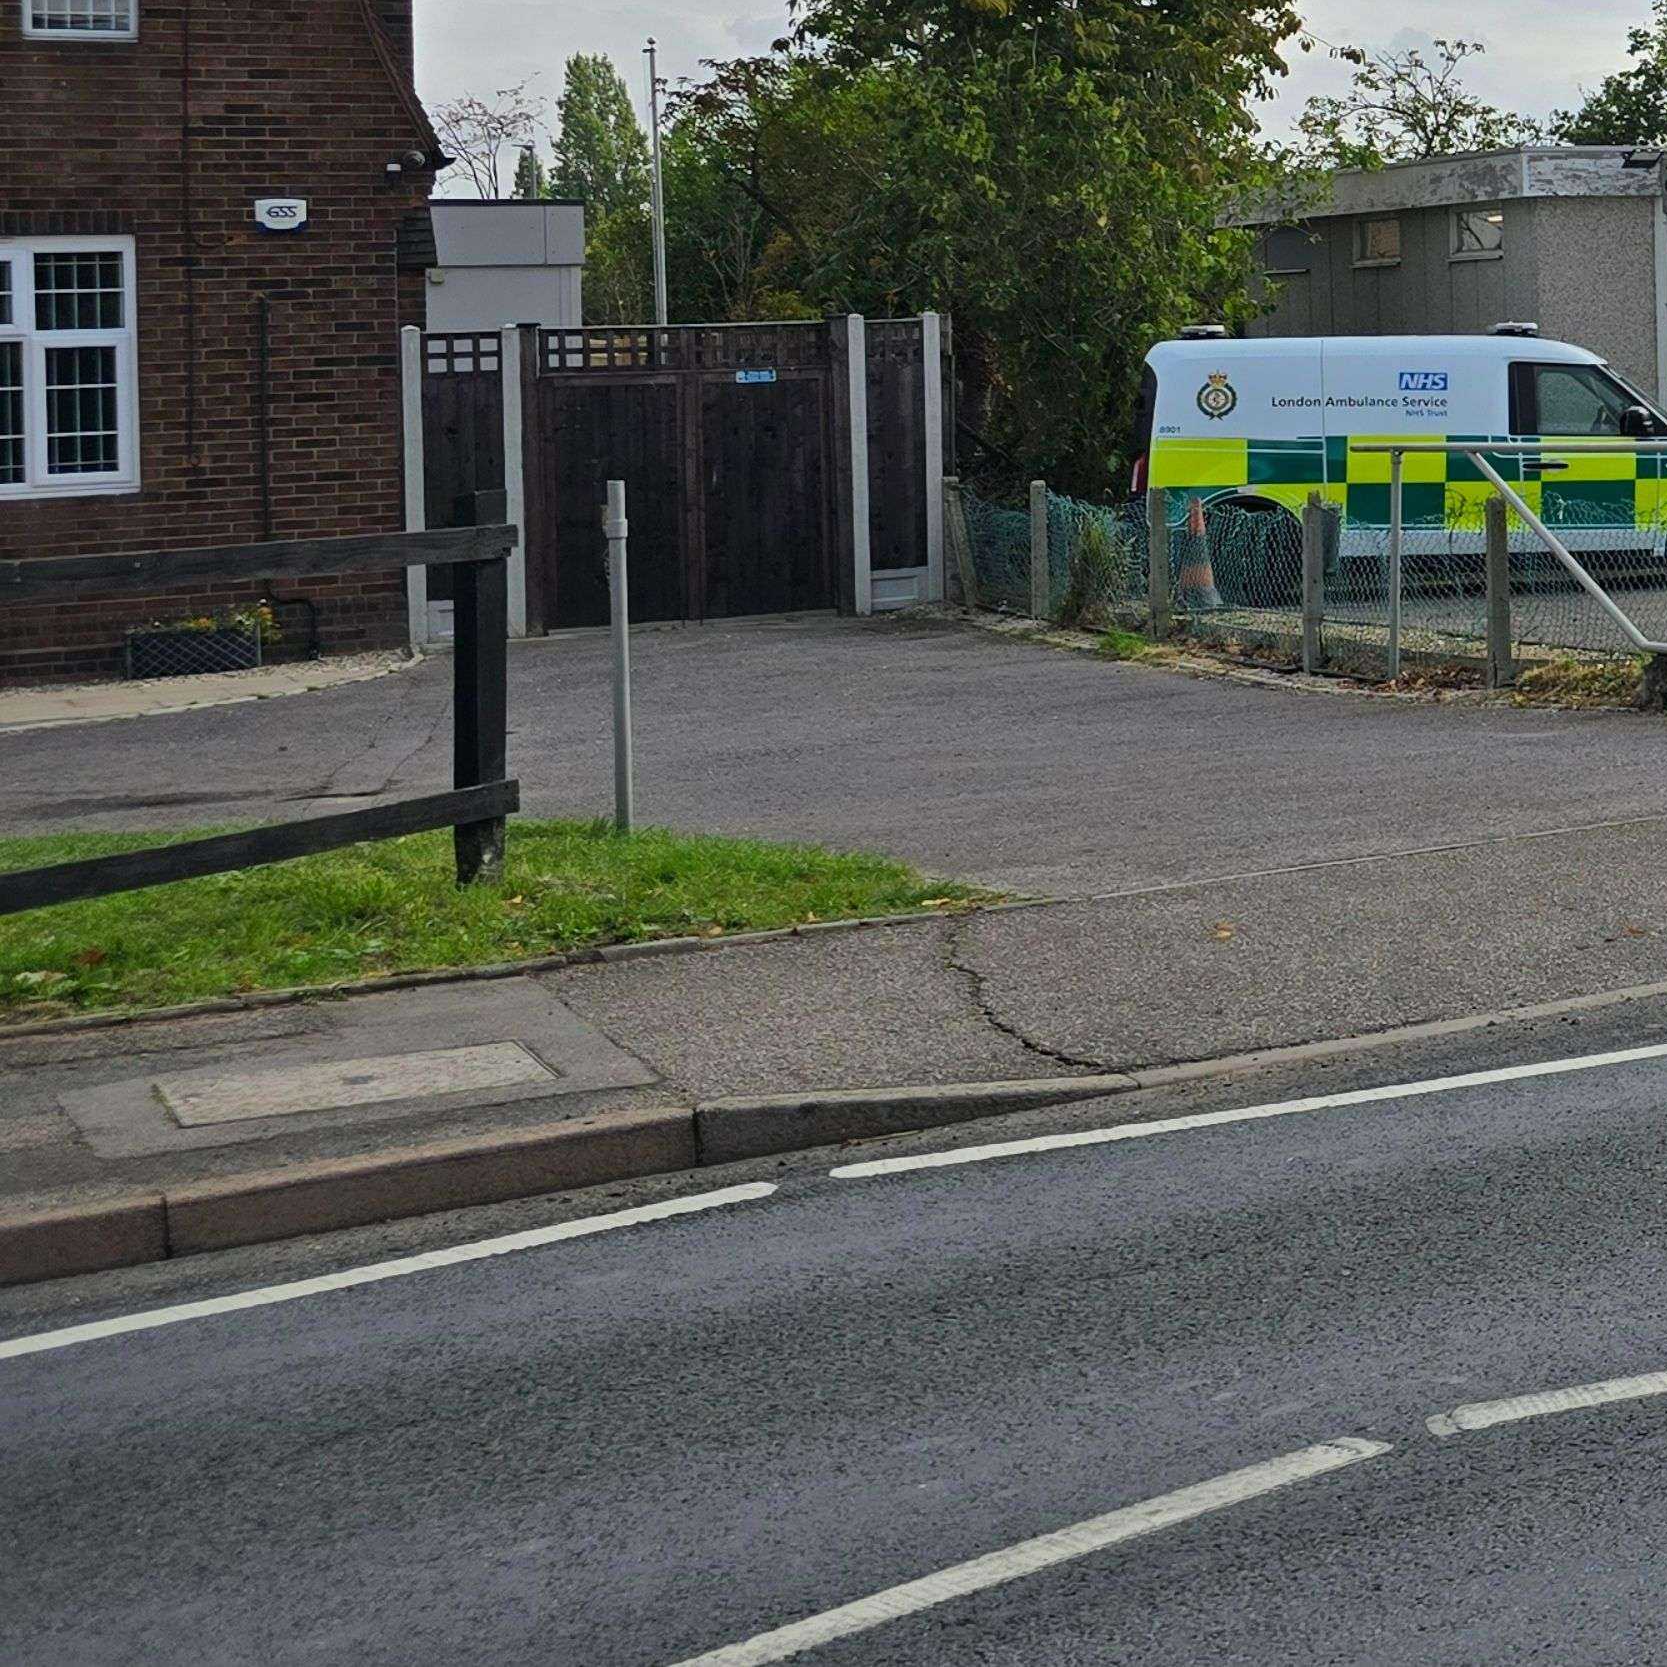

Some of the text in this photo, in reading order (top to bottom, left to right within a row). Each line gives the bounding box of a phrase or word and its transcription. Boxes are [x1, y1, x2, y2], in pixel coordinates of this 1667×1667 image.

[1400, 373, 1447, 390] NHS
[1271, 395, 1448, 407] London Ambulance Service
